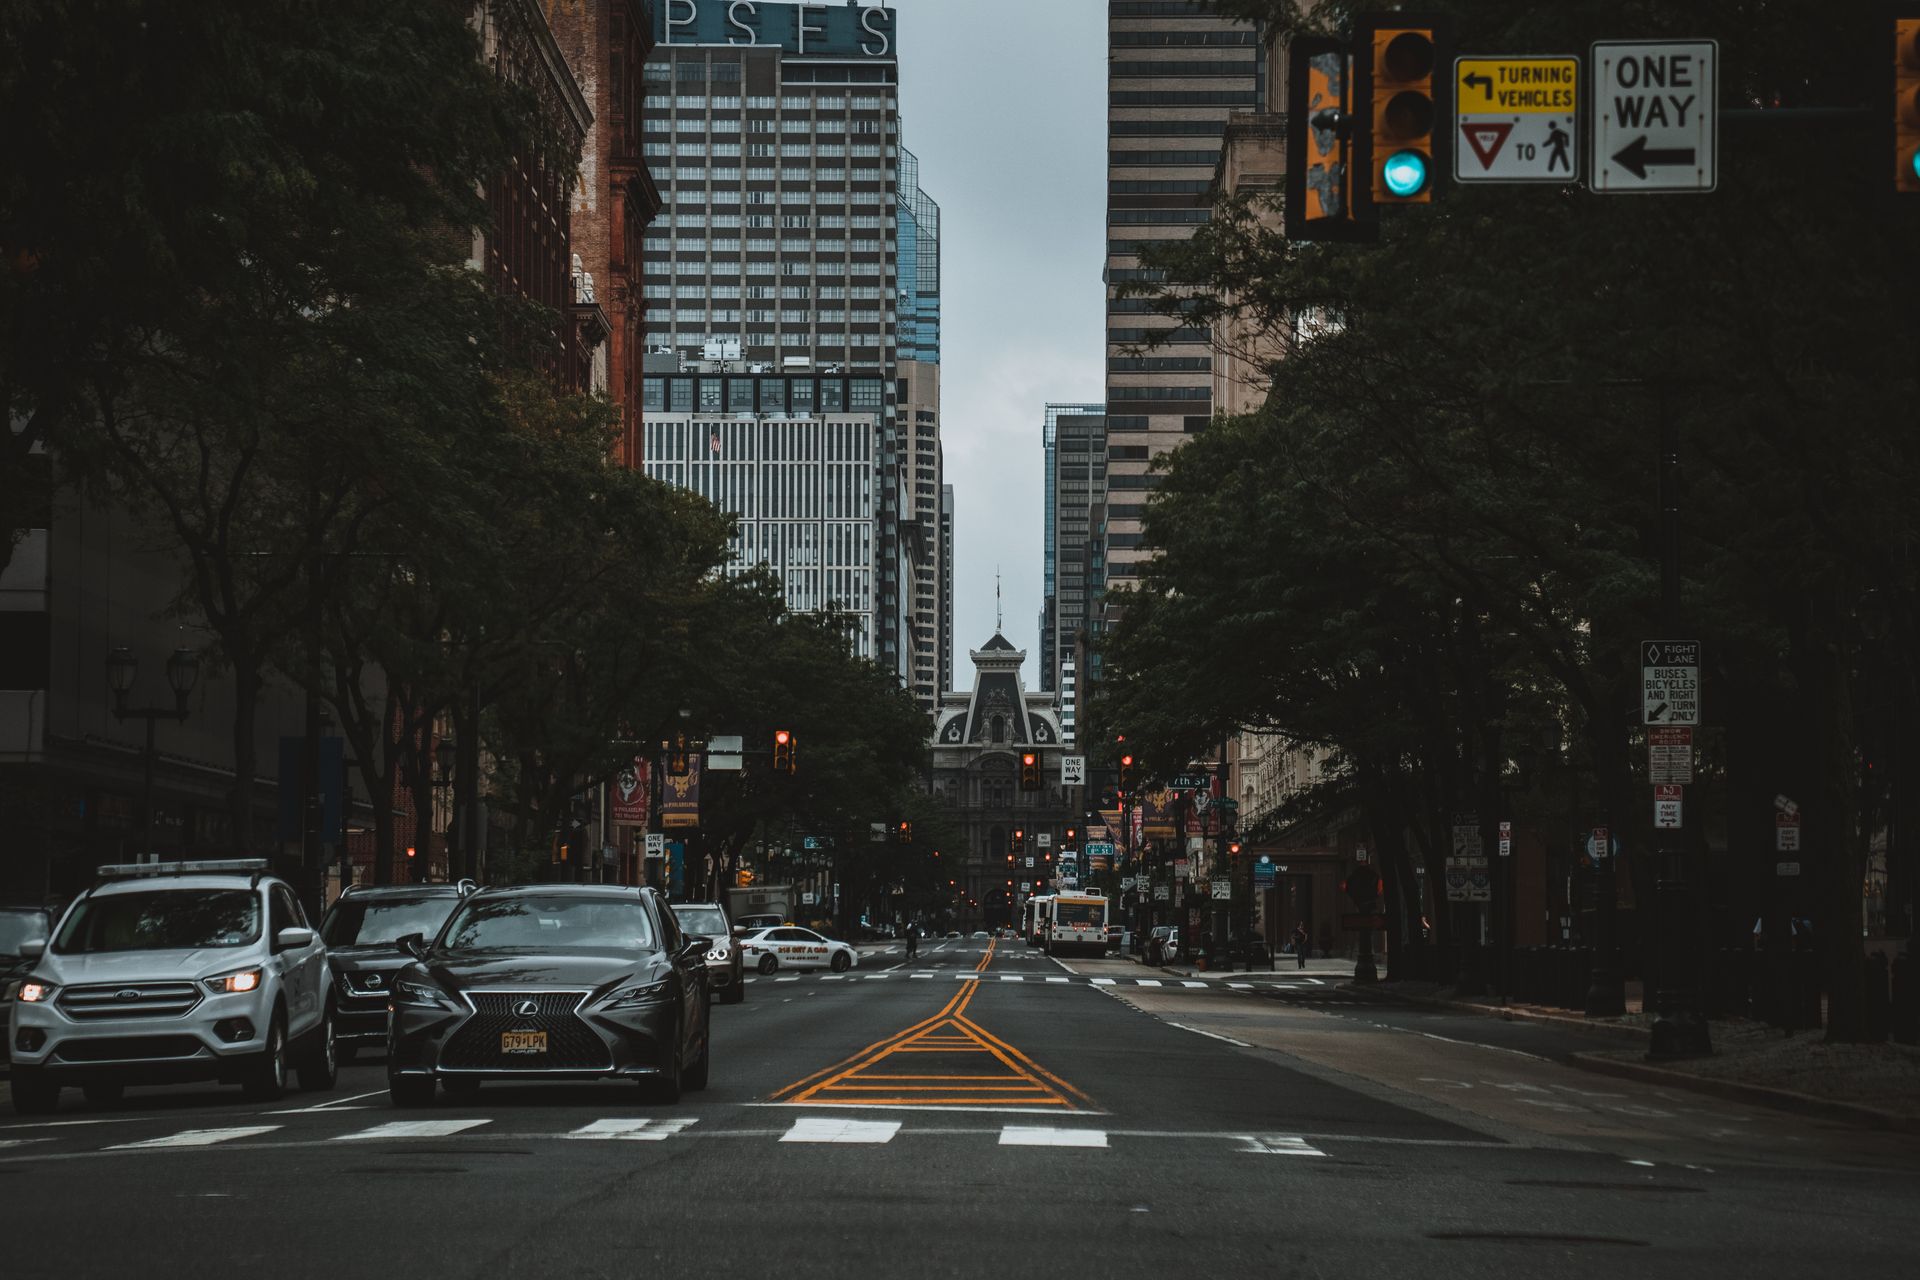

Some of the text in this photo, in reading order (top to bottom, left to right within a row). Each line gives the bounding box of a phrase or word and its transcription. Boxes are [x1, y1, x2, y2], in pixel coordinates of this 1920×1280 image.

[664, 0, 889, 56] PSFS
[1498, 66, 1572, 84] TURNING
[1617, 55, 1692, 89] ONE
[1498, 90, 1572, 107] VEHICLES
[1614, 94, 1695, 128] WAY
[1516, 142, 1535, 161] TO
[1664, 645, 1697, 654] RIGHT
[1667, 655, 1696, 664] LANE
[1654, 669, 1687, 679] BUSES
[1645, 679, 1696, 690] BICYCLES
[1647, 690, 1694, 700] AND RIGHT
[1671, 701, 1696, 710] TURN
[1671, 711, 1696, 721] ONLY
[1065, 758, 1081, 766] ONE
[1065, 766, 1081, 774] WAY
